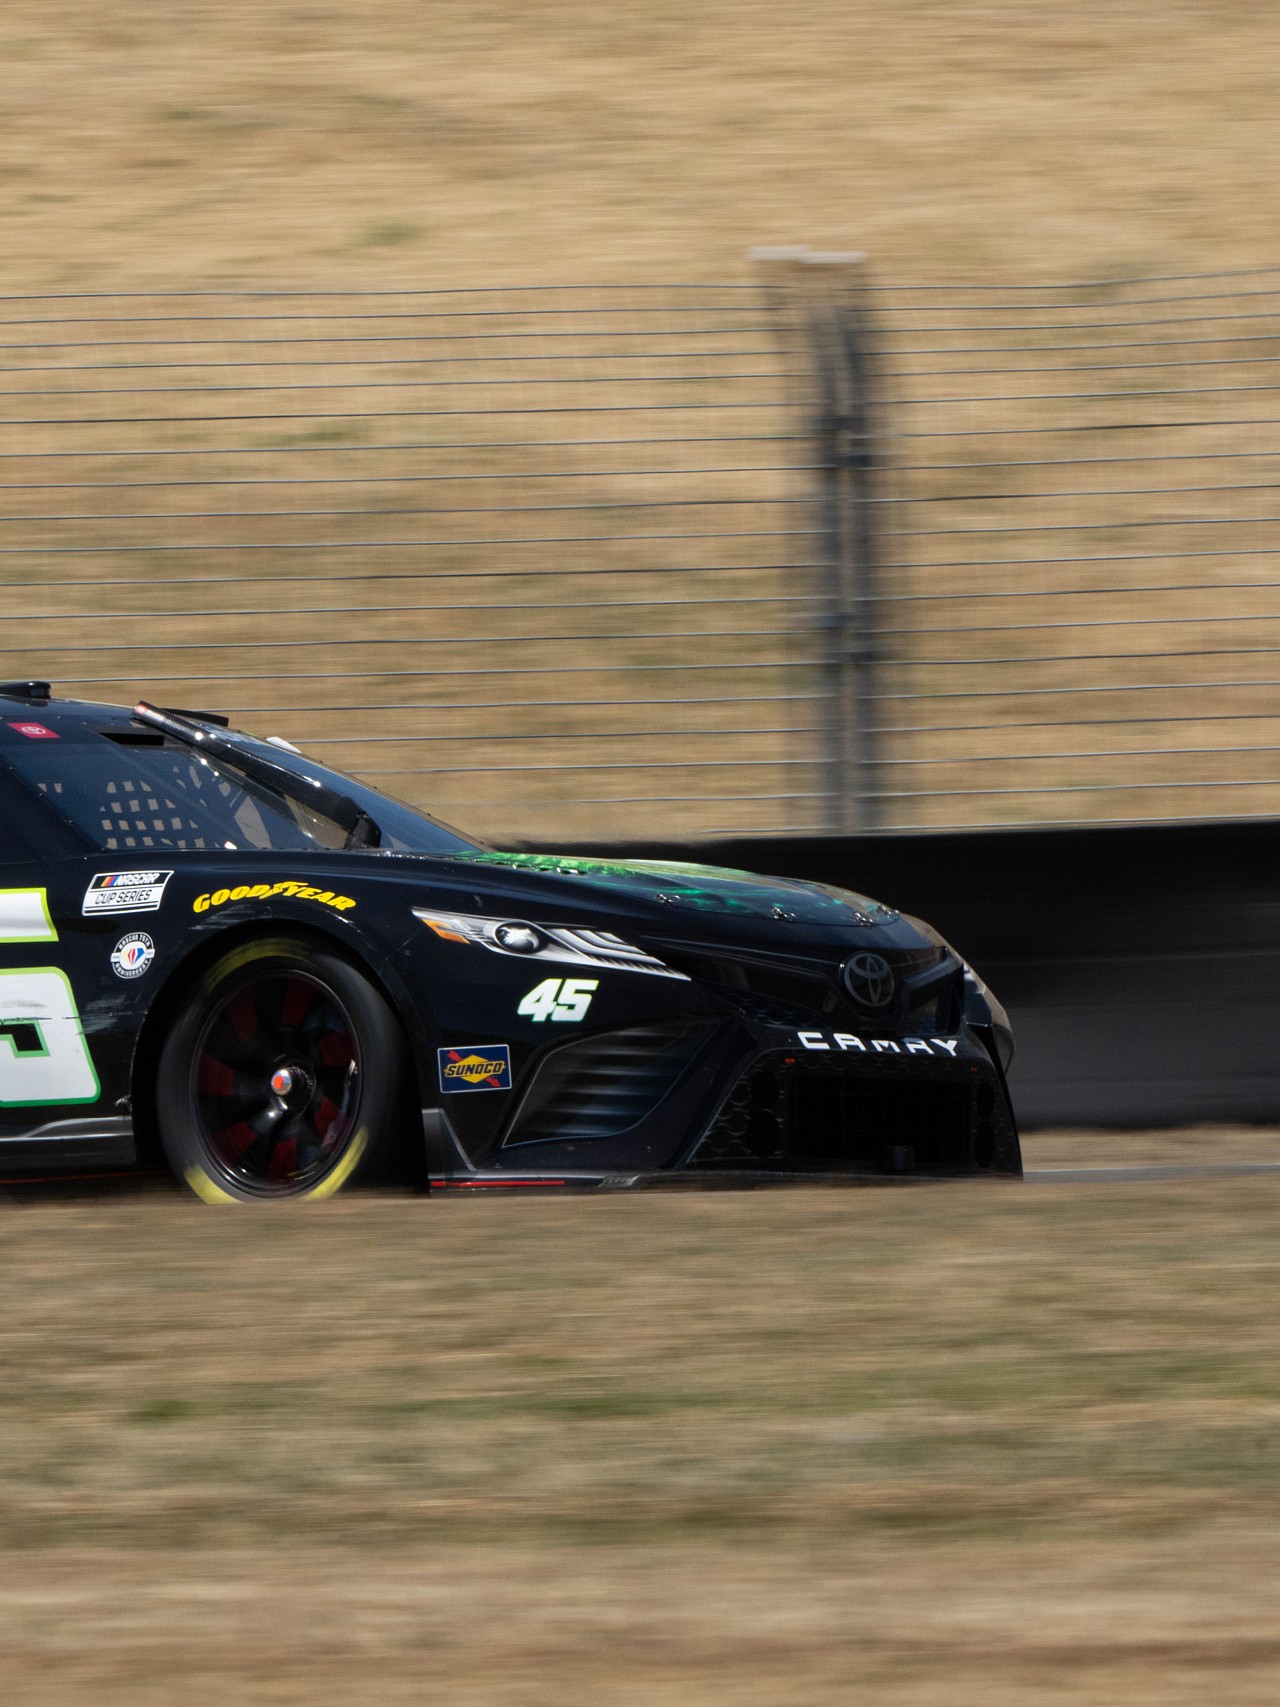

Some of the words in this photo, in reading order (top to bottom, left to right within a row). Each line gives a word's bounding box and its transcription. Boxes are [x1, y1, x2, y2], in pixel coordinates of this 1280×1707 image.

[114, 873, 160, 886] NASCAR
[95, 892, 117, 904] CUP
[116, 889, 152, 903] SERIES
[193, 881, 357, 913] GOODYEAR
[517, 978, 600, 1022] 45
[446, 1062, 502, 1076] SUNOCO
